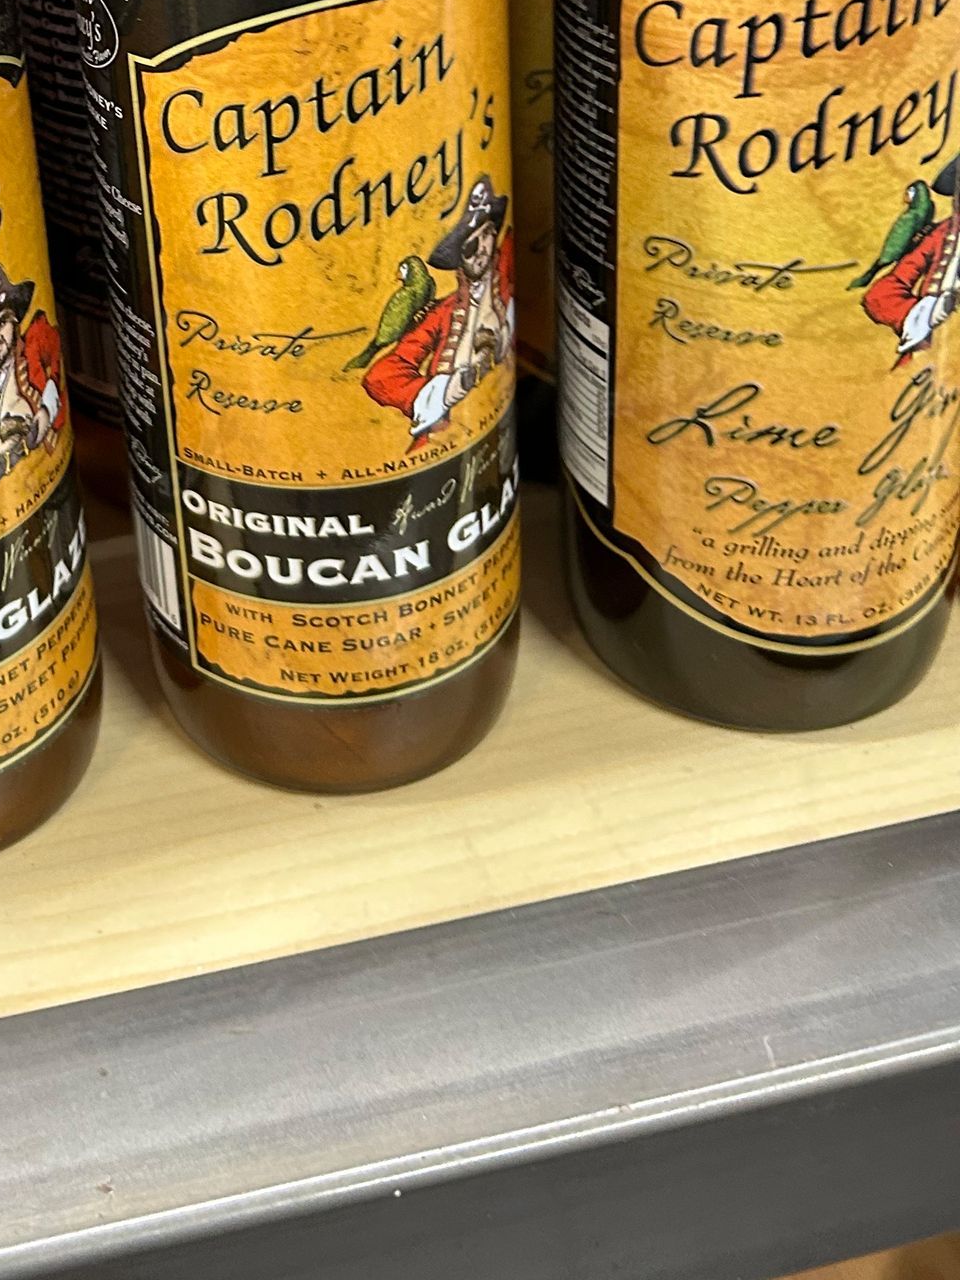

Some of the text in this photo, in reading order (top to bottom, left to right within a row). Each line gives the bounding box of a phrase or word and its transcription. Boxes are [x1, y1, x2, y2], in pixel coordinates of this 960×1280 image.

[161, 31, 455, 179] Captain
[196, 90, 496, 267] Rodney's
[643, 234, 860, 292] Private
[174, 310, 368, 363] Private
[648, 297, 783, 347] Reserve
[185, 369, 305, 417] Reserve
[646, 382, 843, 448] Lime
[183, 447, 304, 483] SMALL-BATCH
[341, 440, 458, 482] ALL-NATURAL
[181, 488, 375, 538] ORIGINAL
[704, 475, 847, 538] Pepper
[188, 527, 431, 587] BOUCAN
[664, 544, 716, 578] from
[725, 561, 764, 585] the
[772, 567, 843, 589] Heart
[850, 556, 874, 587] of
[877, 551, 908, 577] the
[723, 534, 810, 564] grilling
[818, 530, 866, 559] and
[199, 612, 255, 644] PURE
[264, 634, 333, 654] CANE
[342, 626, 422, 654] SUGAR
[442, 578, 499, 626] SWEET
[225, 571, 478, 629] WITH SCOTCH BONNET
[697, 582, 740, 610] NET
[747, 604, 784, 624] WT.
[279, 668, 322, 684] NET
[329, 663, 409, 685] WEIGHT
[418, 651, 440, 668] 18
[33, 688, 65, 725] (510
